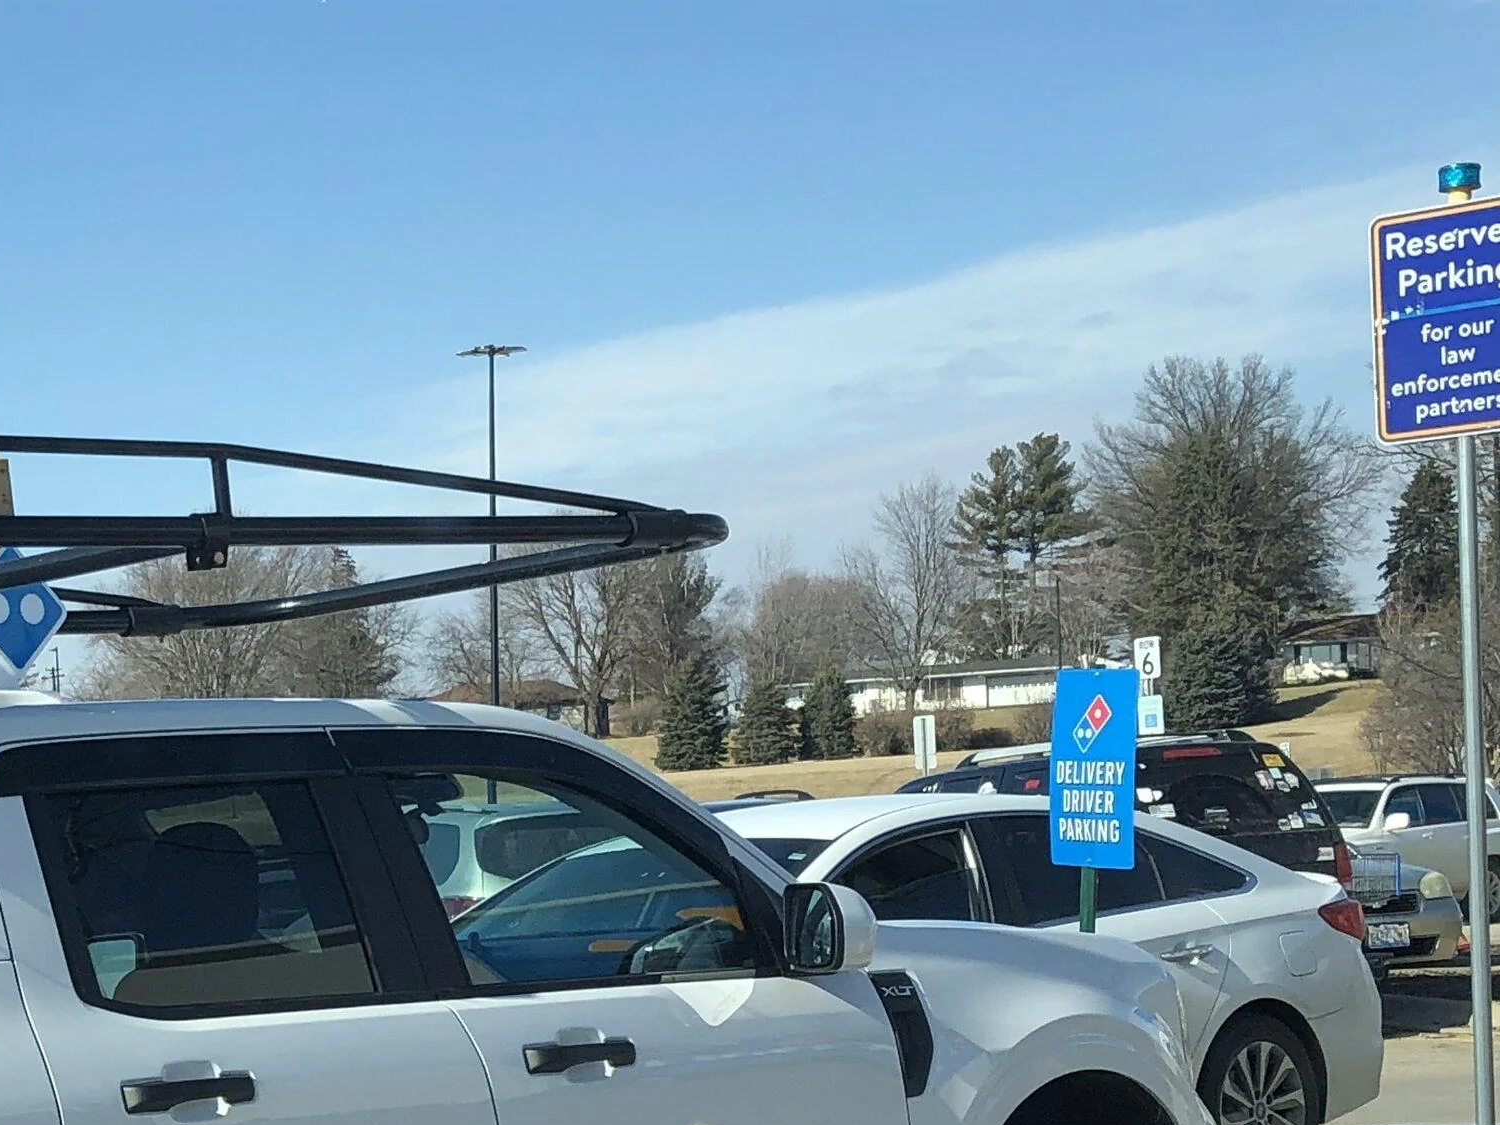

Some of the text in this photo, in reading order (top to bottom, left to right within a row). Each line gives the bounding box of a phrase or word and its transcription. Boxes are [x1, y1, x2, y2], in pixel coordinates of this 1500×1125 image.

[1420, 318, 1495, 344] for our
[1440, 345, 1477, 366] law
[1142, 652, 1154, 675] 6
[1056, 759, 1126, 786] DELIVERY
[1062, 789, 1115, 814] DRIVER
[1058, 817, 1120, 843] PARKING
[880, 984, 915, 997] XLT
